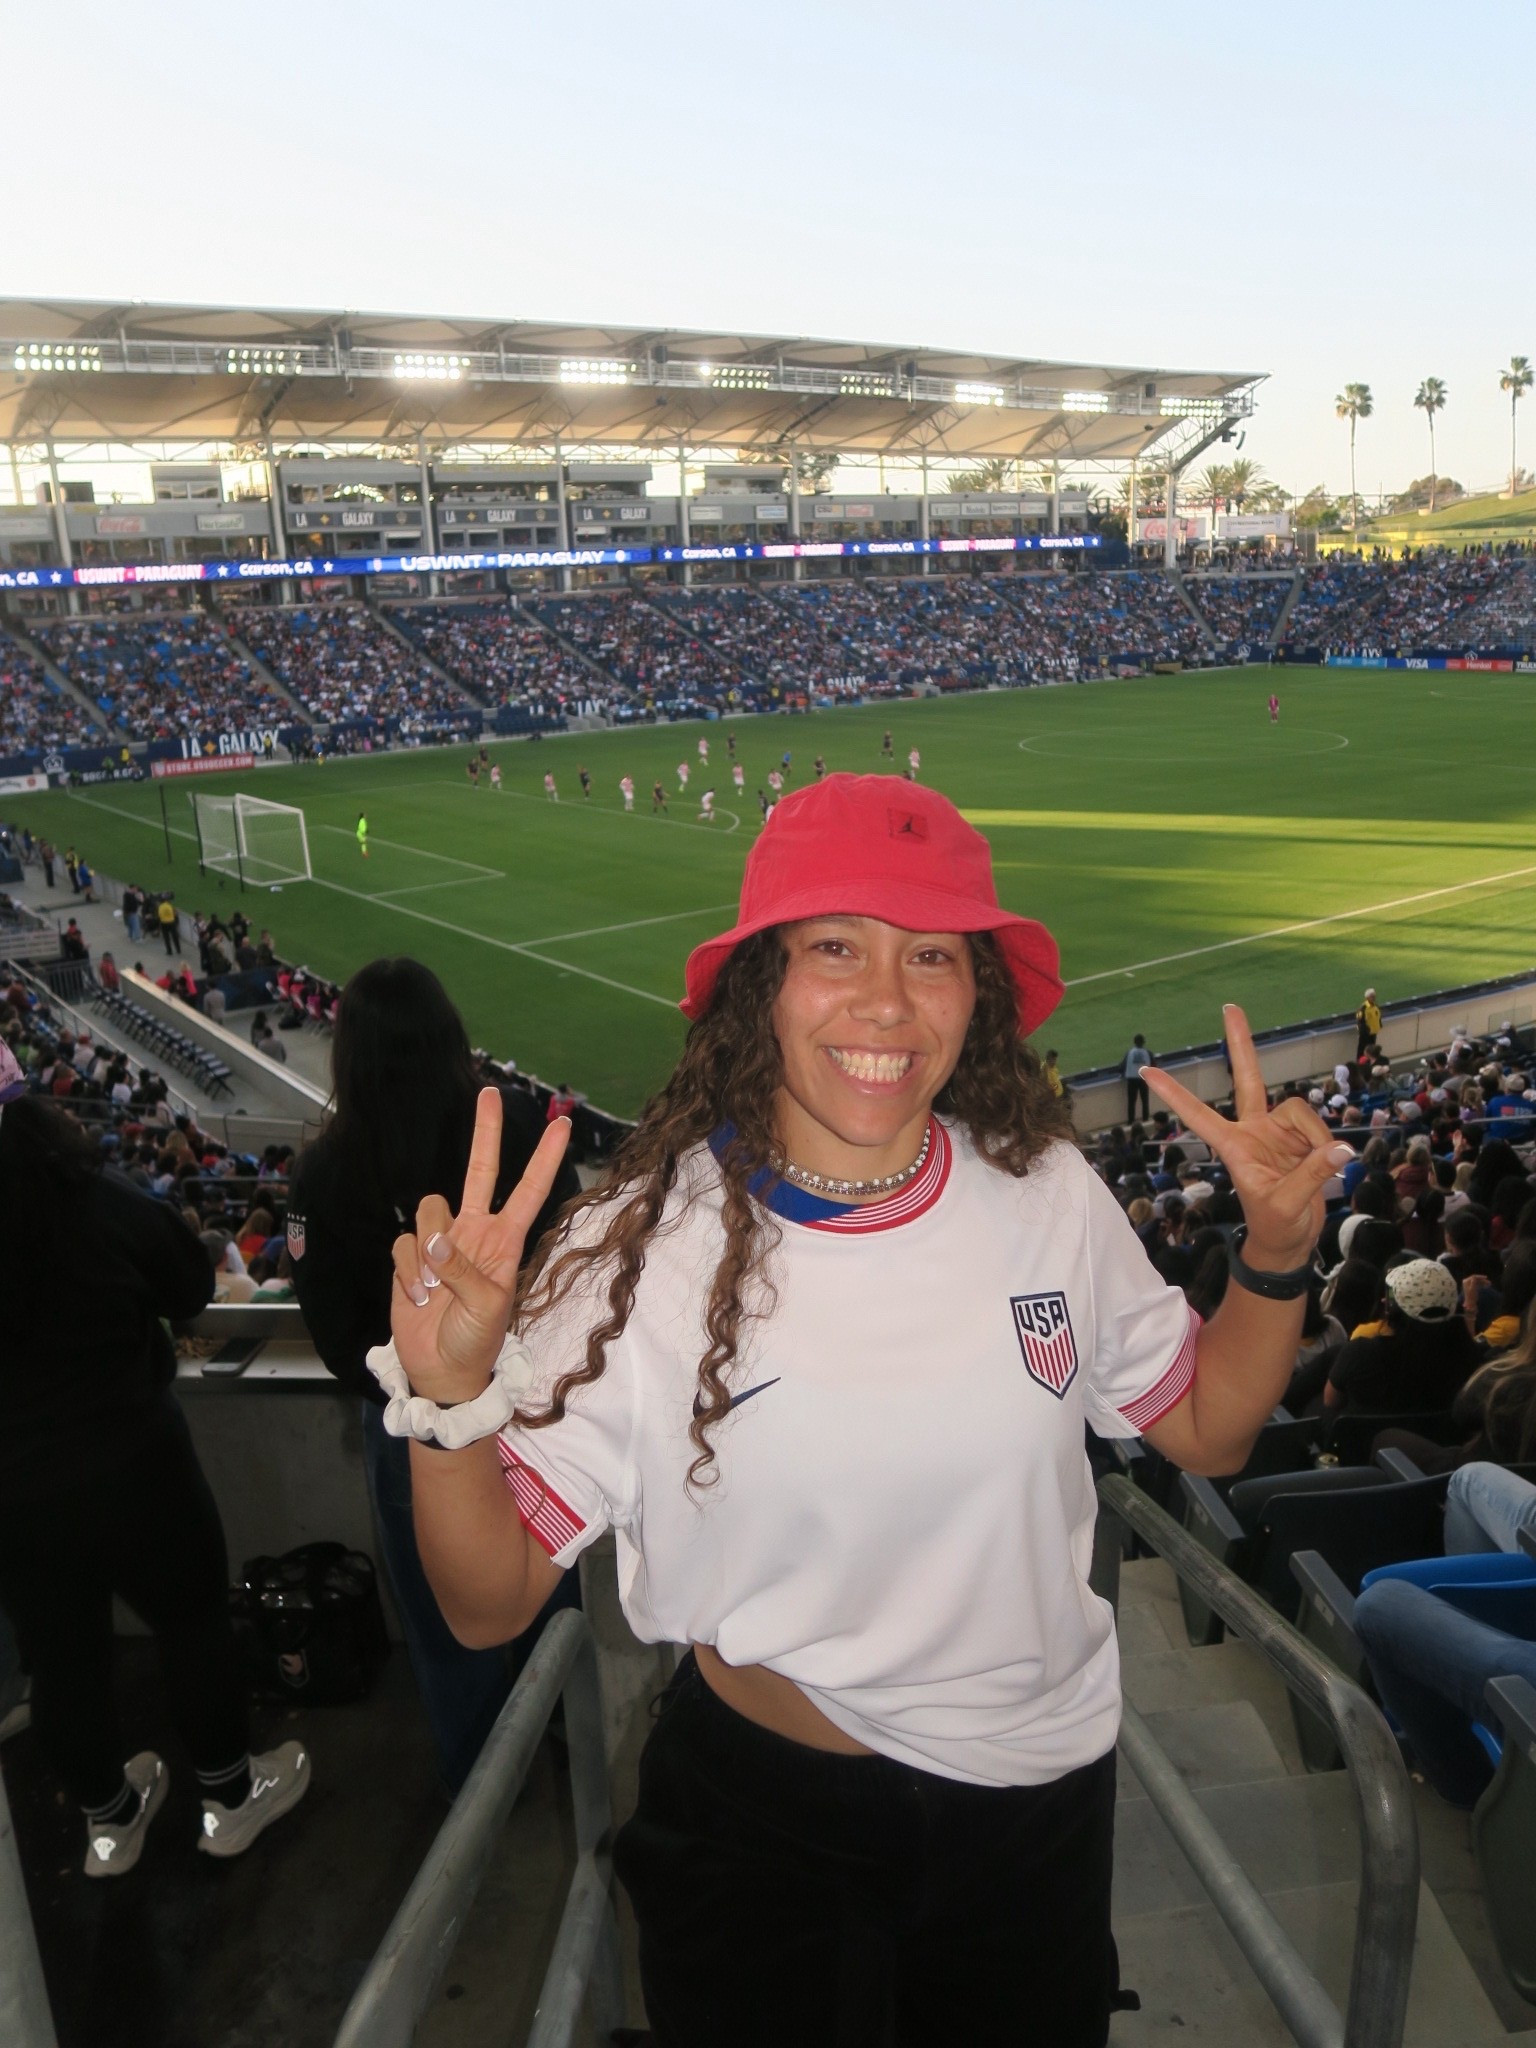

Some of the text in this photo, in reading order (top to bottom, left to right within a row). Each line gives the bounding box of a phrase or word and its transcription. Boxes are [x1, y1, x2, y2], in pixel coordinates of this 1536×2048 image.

[295, 512, 374, 527] LA GALAXY
[445, 509, 516, 523] LA GALAXY
[583, 507, 647, 520] LA GALAXY
[902, 542, 915, 552] CA
[1039, 537, 1085, 548] Carson, CA
[682, 547, 737, 559] Carson, CA
[400, 550, 605, 571] USWNT PARAGUAY
[135, 564, 203, 582] PARAGUAY
[239, 561, 314, 577] Carson, CA
[16, 571, 39, 586] CA
[1405, 658, 1429, 669] VISA
[1017, 1299, 1065, 1339] USA
